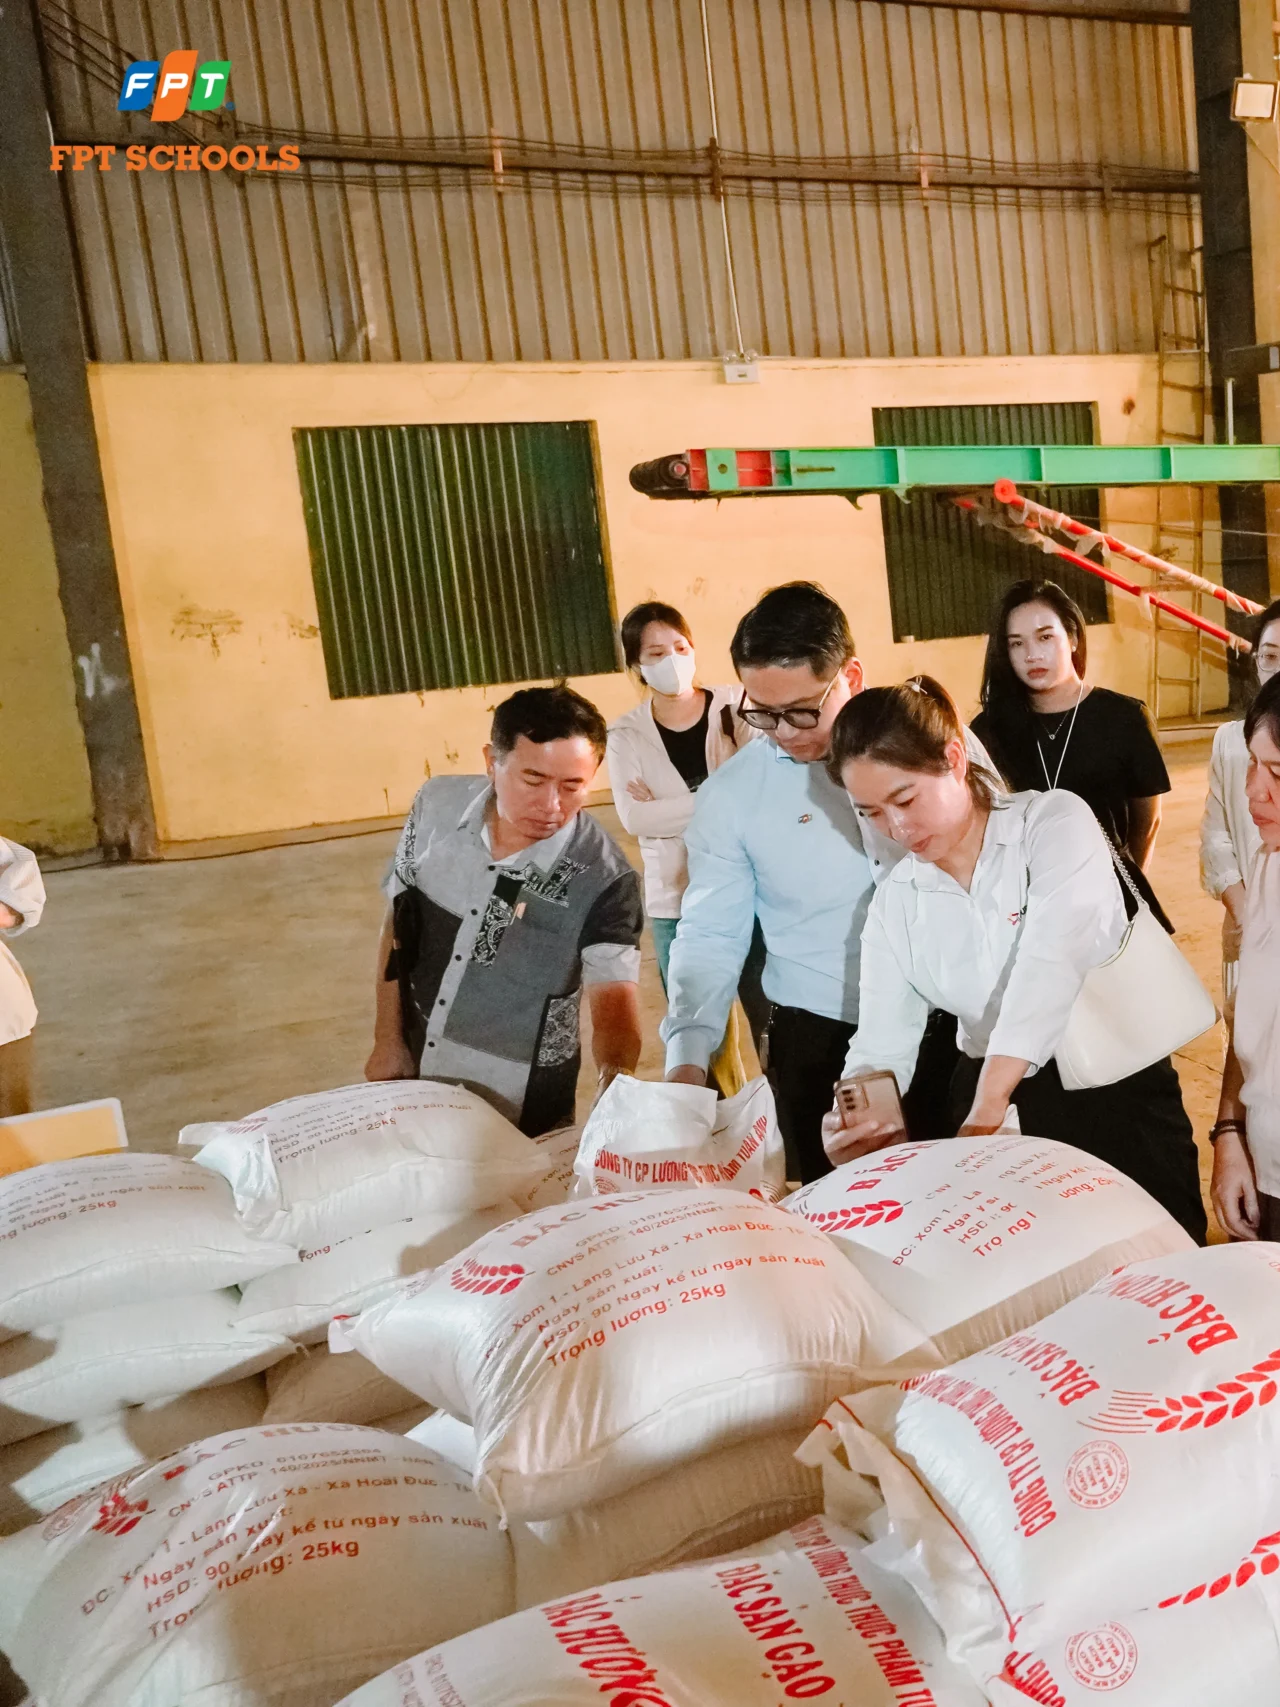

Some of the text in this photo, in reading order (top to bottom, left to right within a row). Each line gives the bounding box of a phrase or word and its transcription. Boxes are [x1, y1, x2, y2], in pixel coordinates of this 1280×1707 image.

[622, 1157, 633, 1180] TY
[634, 1162, 649, 1184] CP
[78, 1200, 118, 1213] 25kg
[546, 1252, 586, 1276] CNVS
[591, 1302, 612, 1320] 90
[547, 1328, 606, 1368] Trọng
[679, 1282, 728, 1305] 25kg
[302, 1539, 360, 1563] 25kg
[147, 1576, 200, 1613] HSD:
[204, 1560, 231, 1582] 90
